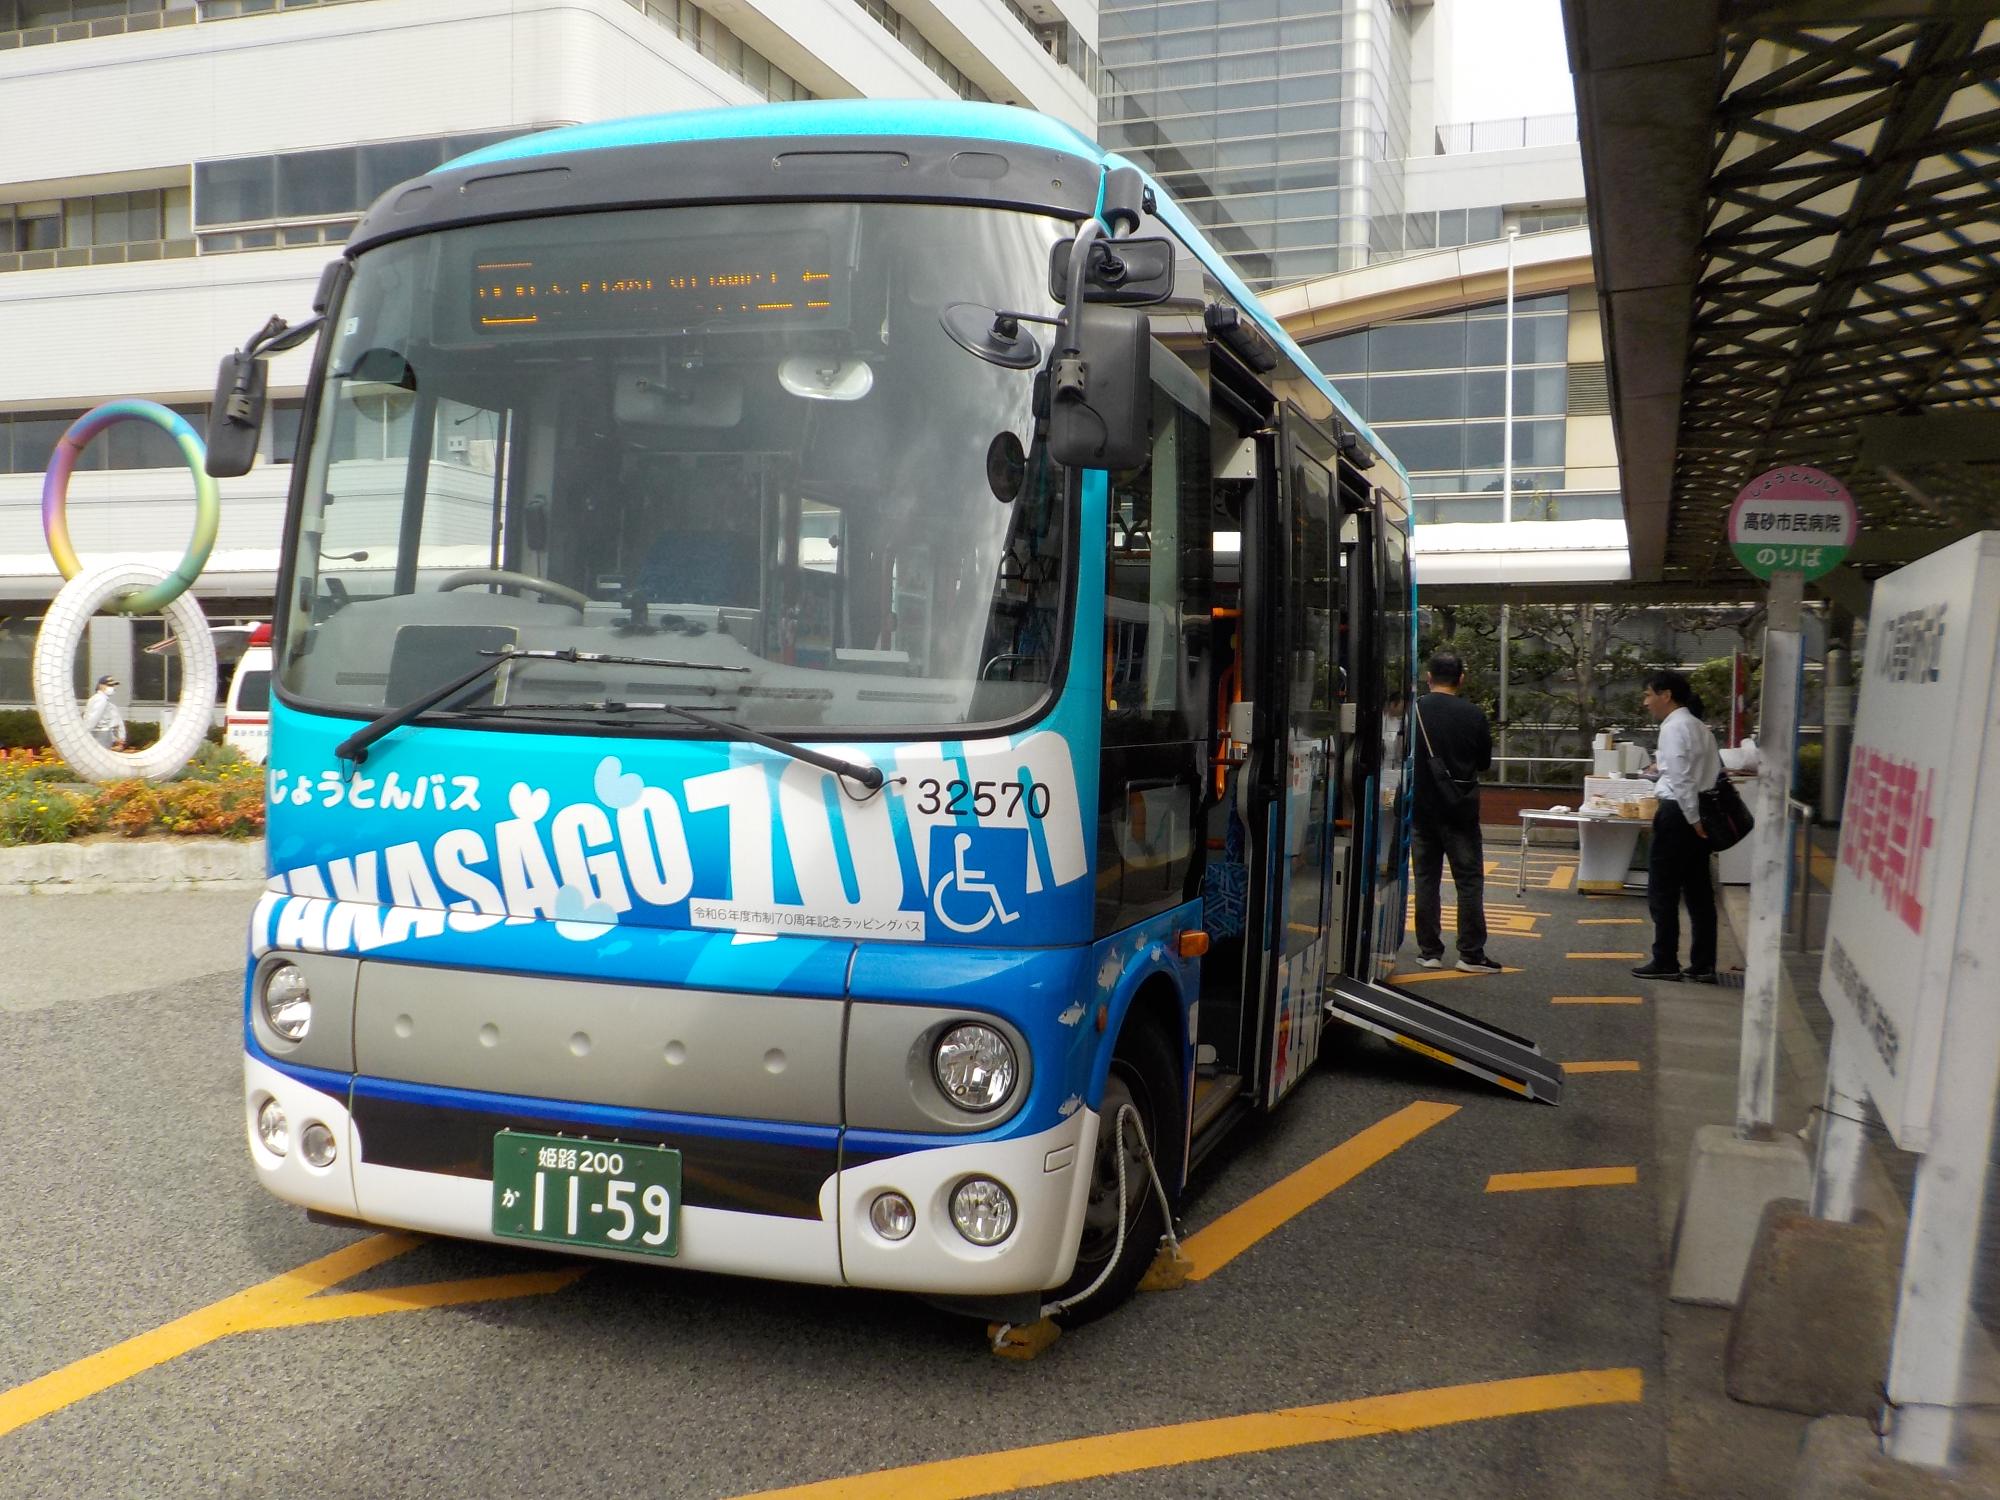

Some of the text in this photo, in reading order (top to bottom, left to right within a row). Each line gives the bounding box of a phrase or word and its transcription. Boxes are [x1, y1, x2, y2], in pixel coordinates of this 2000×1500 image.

[1743, 511, 1841, 533] 高砂市民病院
[1755, 548, 1823, 567] のりば
[269, 770, 481, 812] じょうとんバス
[916, 777, 1050, 820] 32570
[693, 906, 922, 934] 令和6年度市制70周年記念ラッピングバス
[538, 1146, 624, 1175] 姫路200
[501, 1171, 670, 1245] か 11-59
